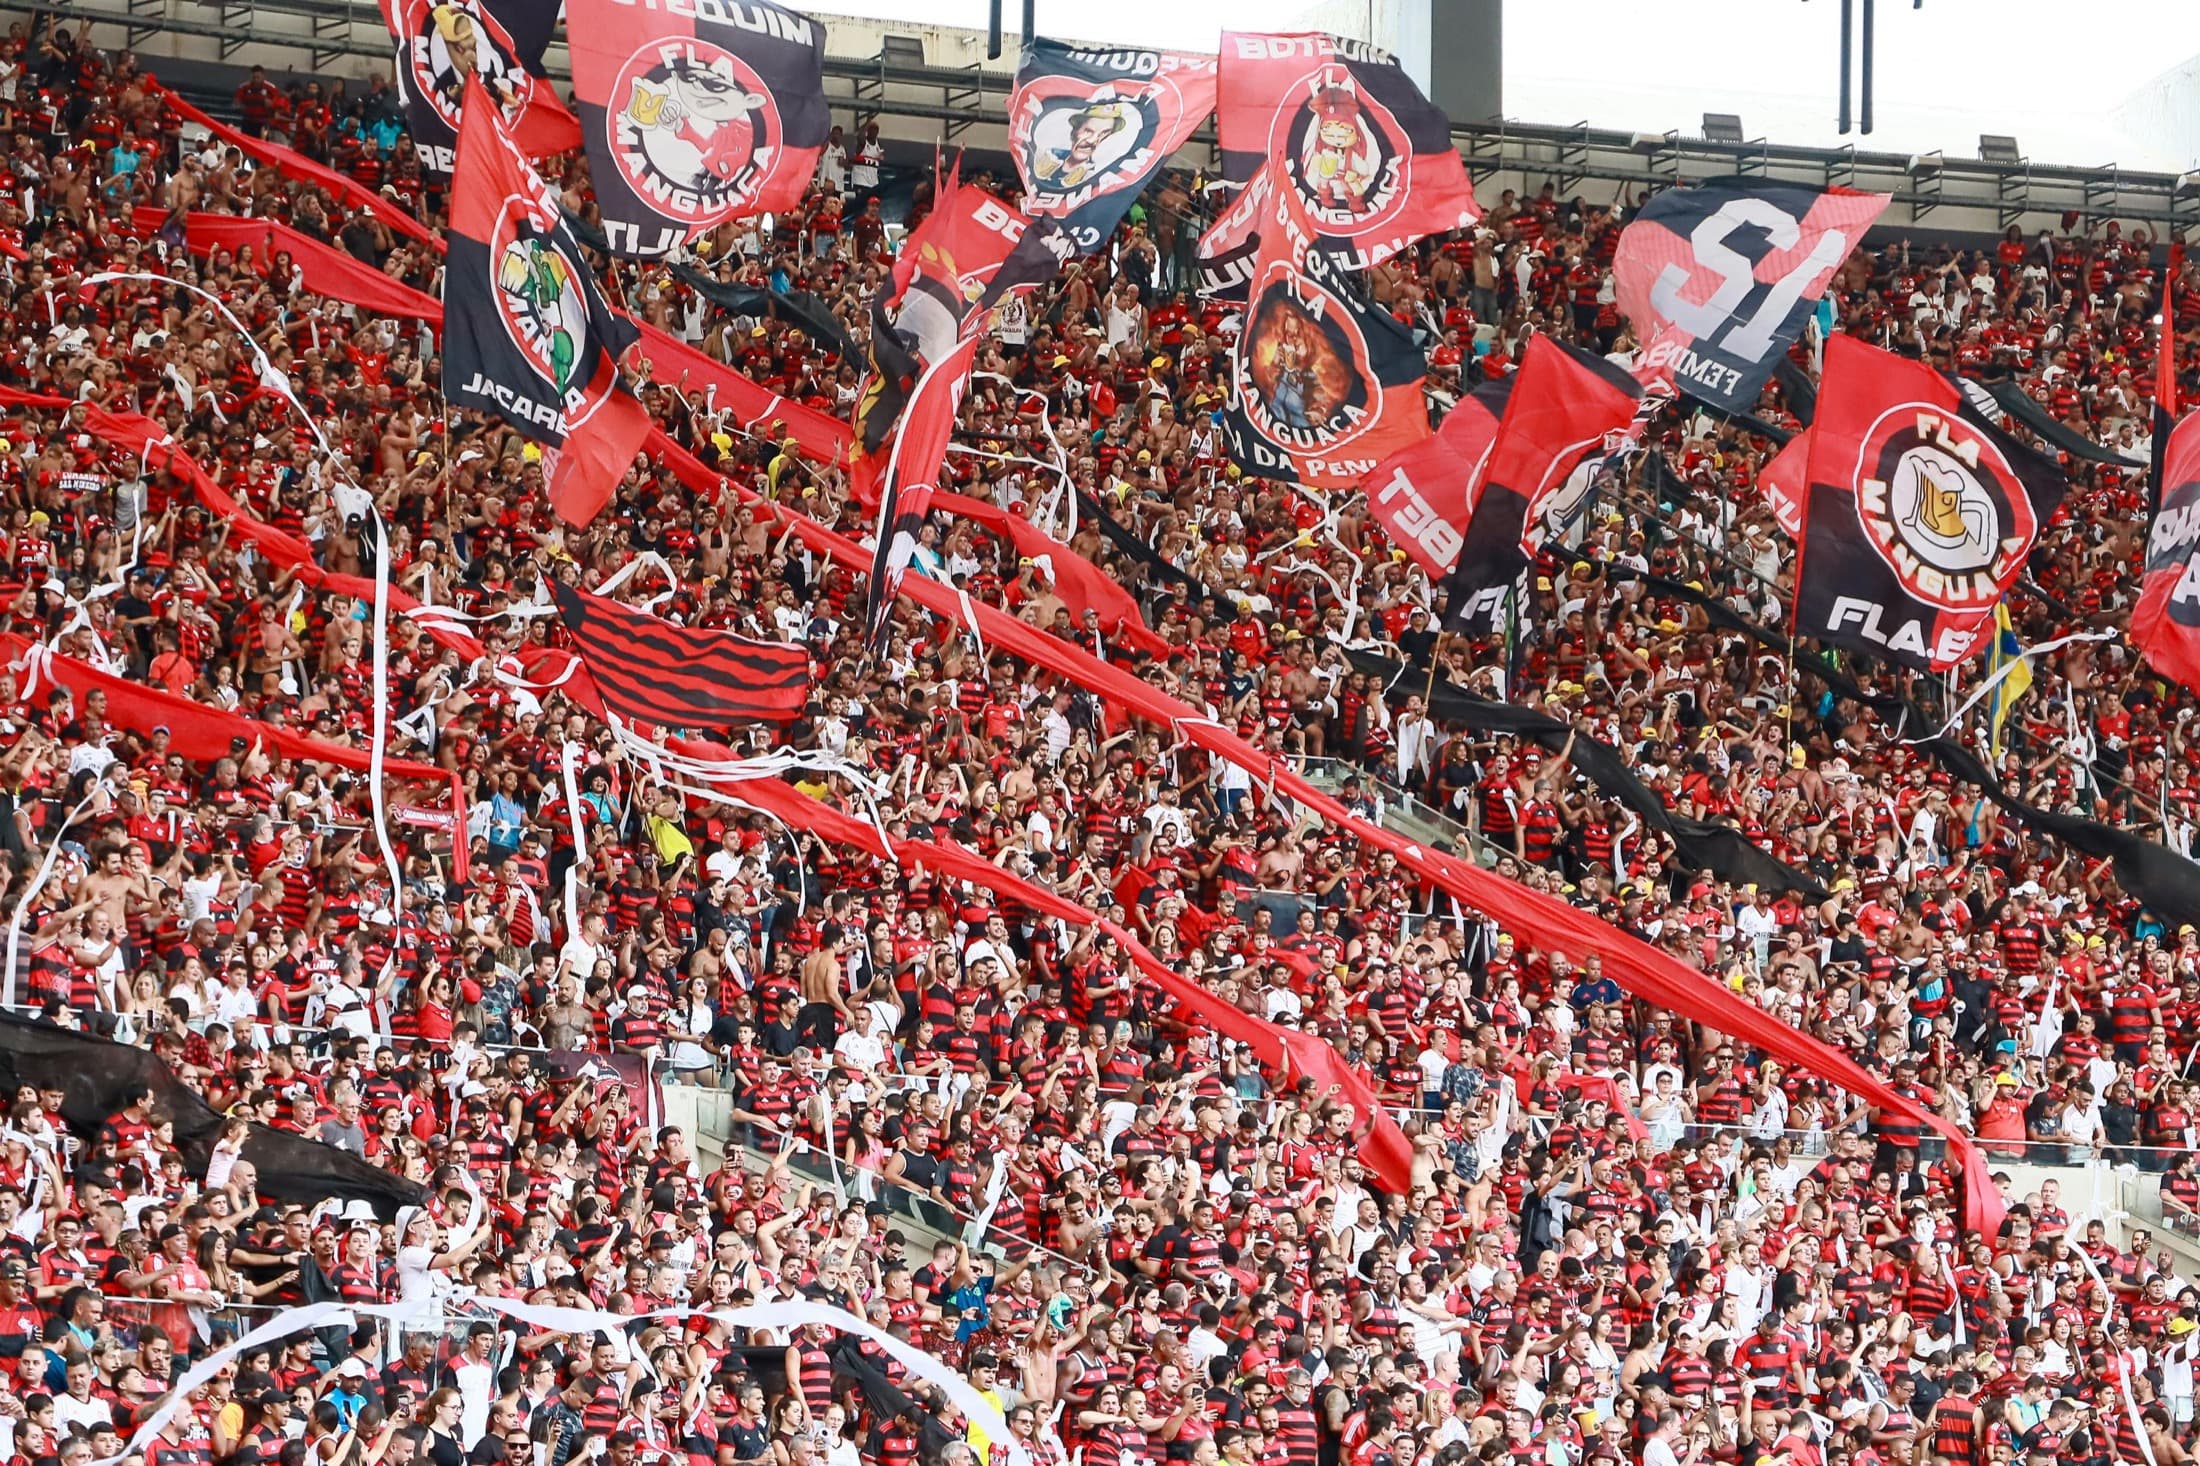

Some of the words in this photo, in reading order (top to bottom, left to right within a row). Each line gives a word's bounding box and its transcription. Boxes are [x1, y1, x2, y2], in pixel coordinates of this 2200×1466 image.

[658, 42, 735, 81] FLA
[1308, 68, 1356, 100] FLA
[1239, 356, 1368, 449] MANGUAÇA
[1918, 412, 1981, 469] FLA
